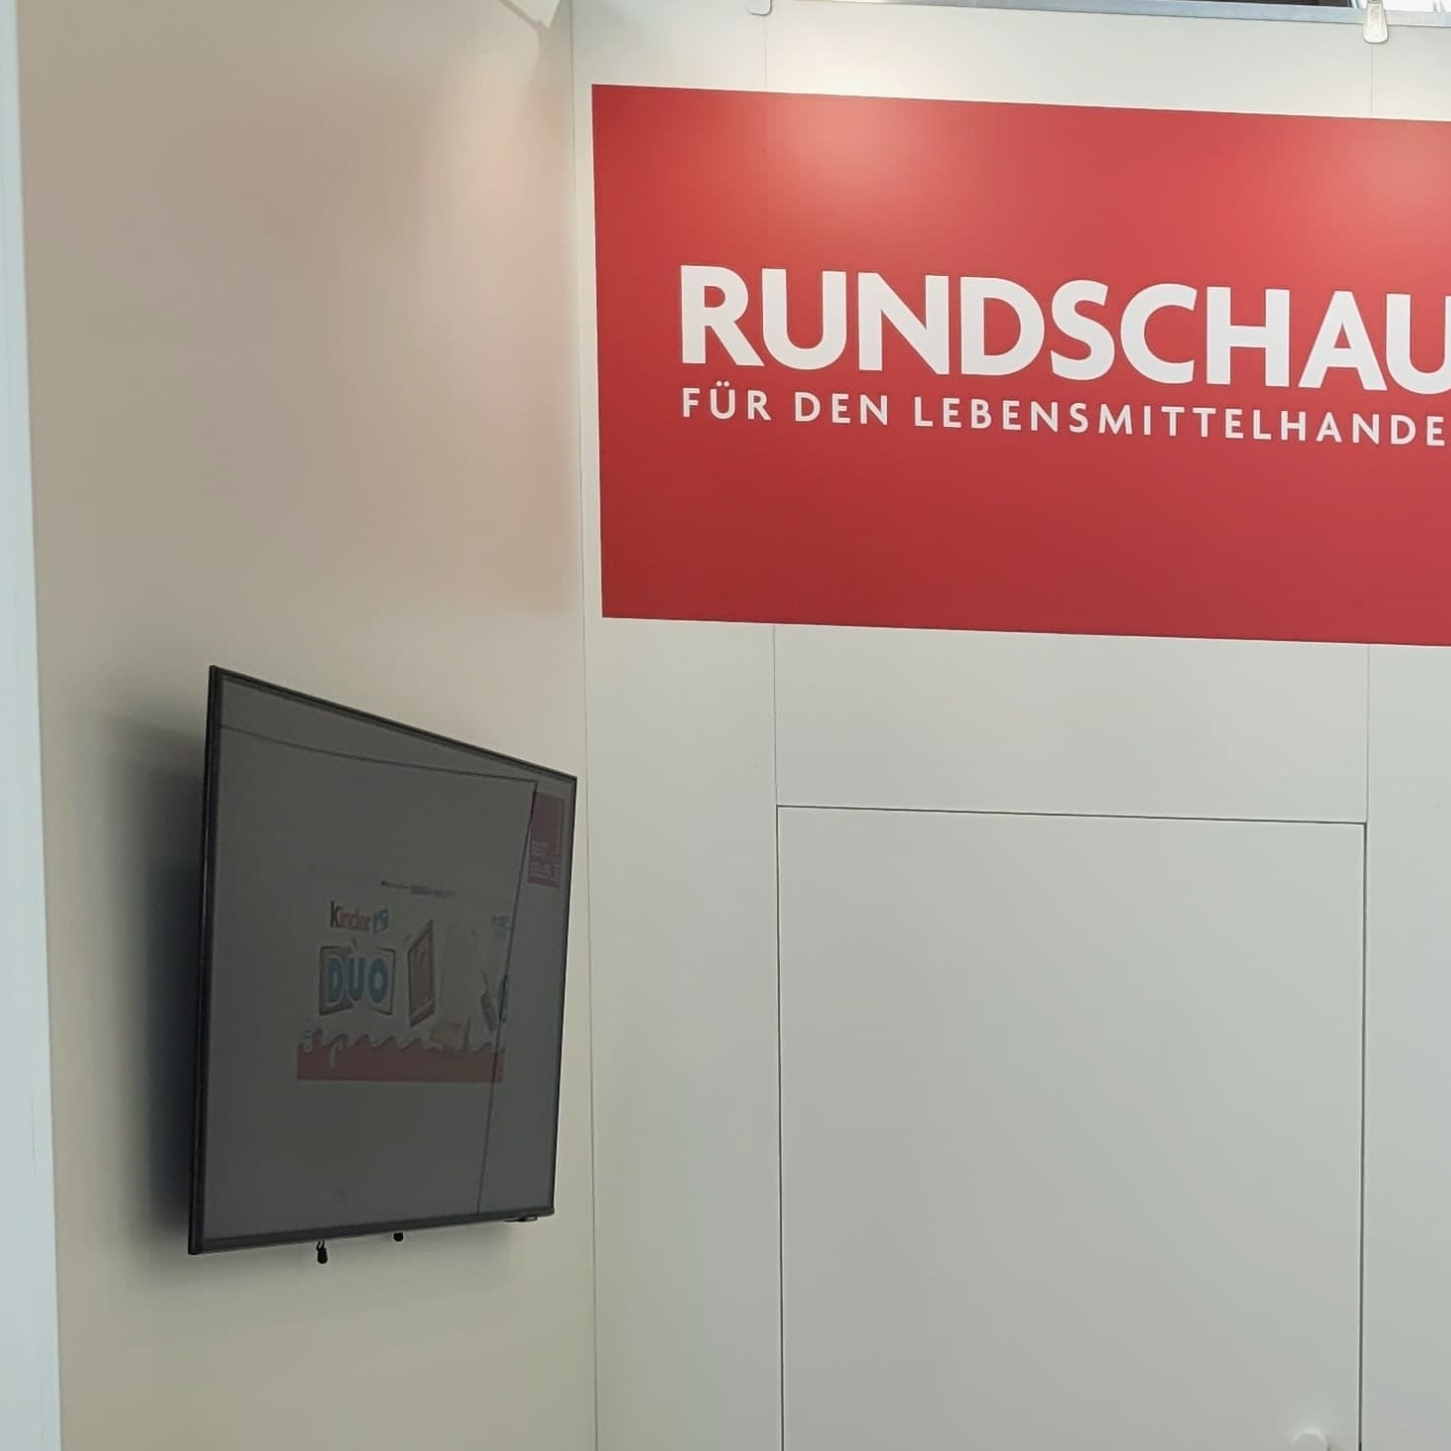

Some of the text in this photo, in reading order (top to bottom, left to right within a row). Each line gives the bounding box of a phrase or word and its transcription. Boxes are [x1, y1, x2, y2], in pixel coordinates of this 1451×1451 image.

[682, 381, 772, 422] FÜR
[795, 392, 890, 426] DEN
[324, 955, 390, 1005] DUO
